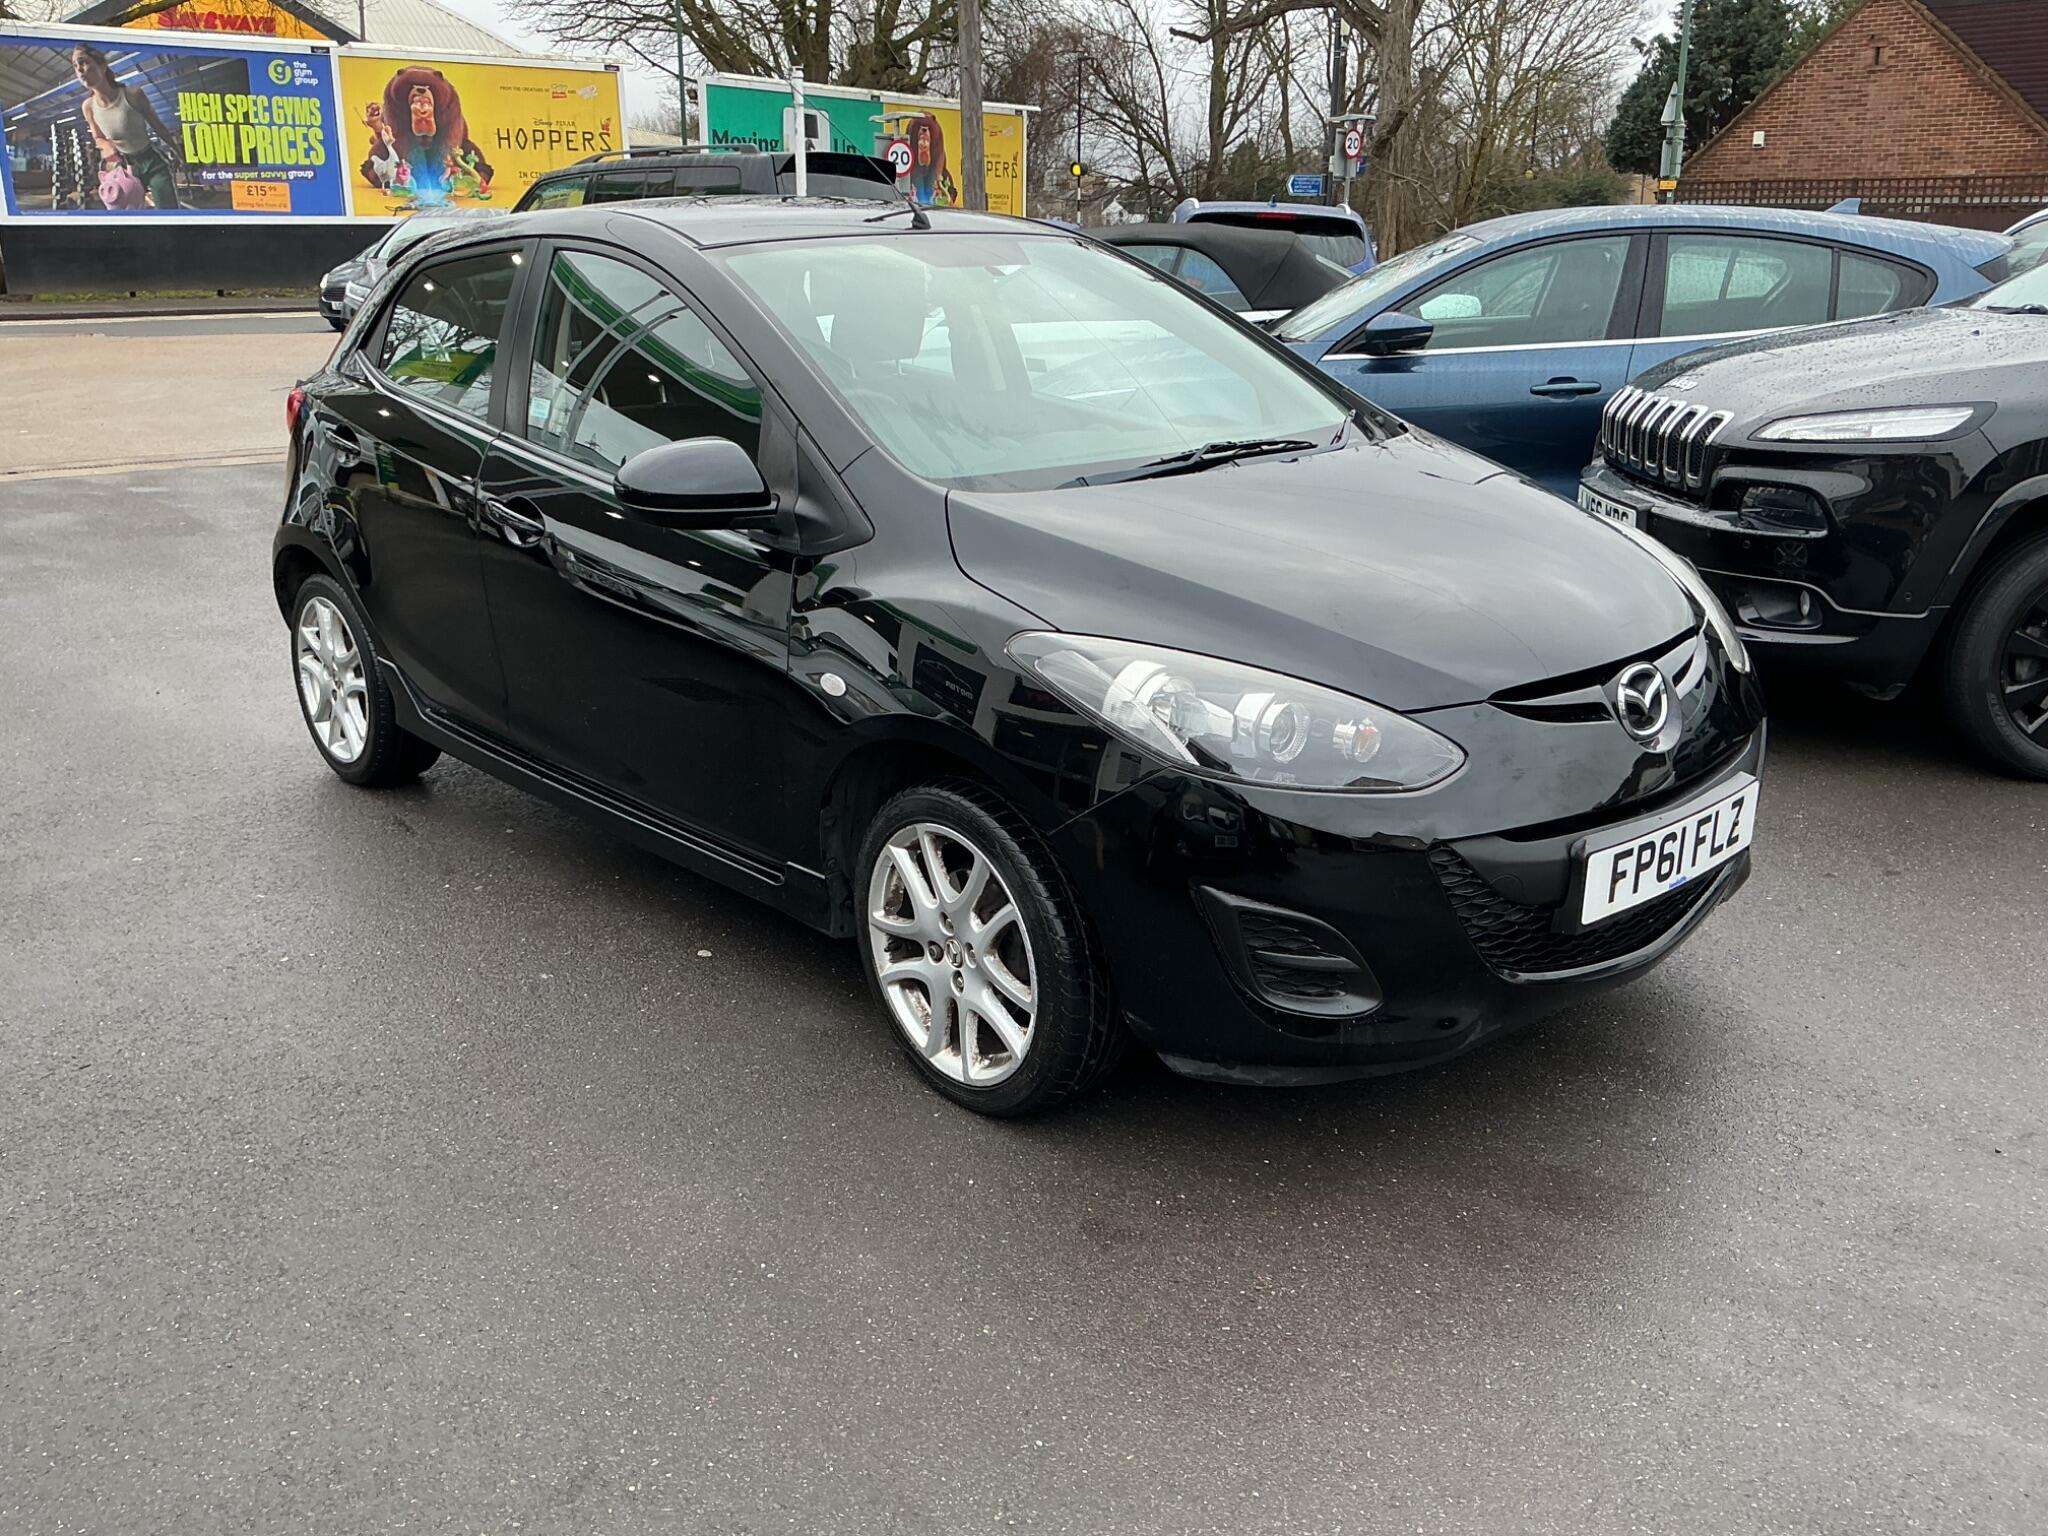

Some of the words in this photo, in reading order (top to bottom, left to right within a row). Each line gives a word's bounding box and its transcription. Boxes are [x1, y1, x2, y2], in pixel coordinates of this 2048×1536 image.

[294, 69, 312, 77] gym
[295, 78, 318, 86] group
[178, 92, 223, 122] HIGH
[224, 94, 270, 124] SPEC
[271, 96, 322, 126] GYMS
[182, 123, 236, 165] LOW
[239, 124, 326, 165] PRICES
[496, 128, 612, 152] HOPPERS
[1347, 138, 1359, 149] 20
[890, 150, 909, 165] 20
[202, 171, 216, 179] for
[218, 171, 233, 179] the
[234, 172, 258, 180] super
[260, 172, 287, 180] savvy
[287, 170, 314, 180] group
[1608, 826, 1687, 903] FP61
[1691, 796, 1745, 868] FLZ
